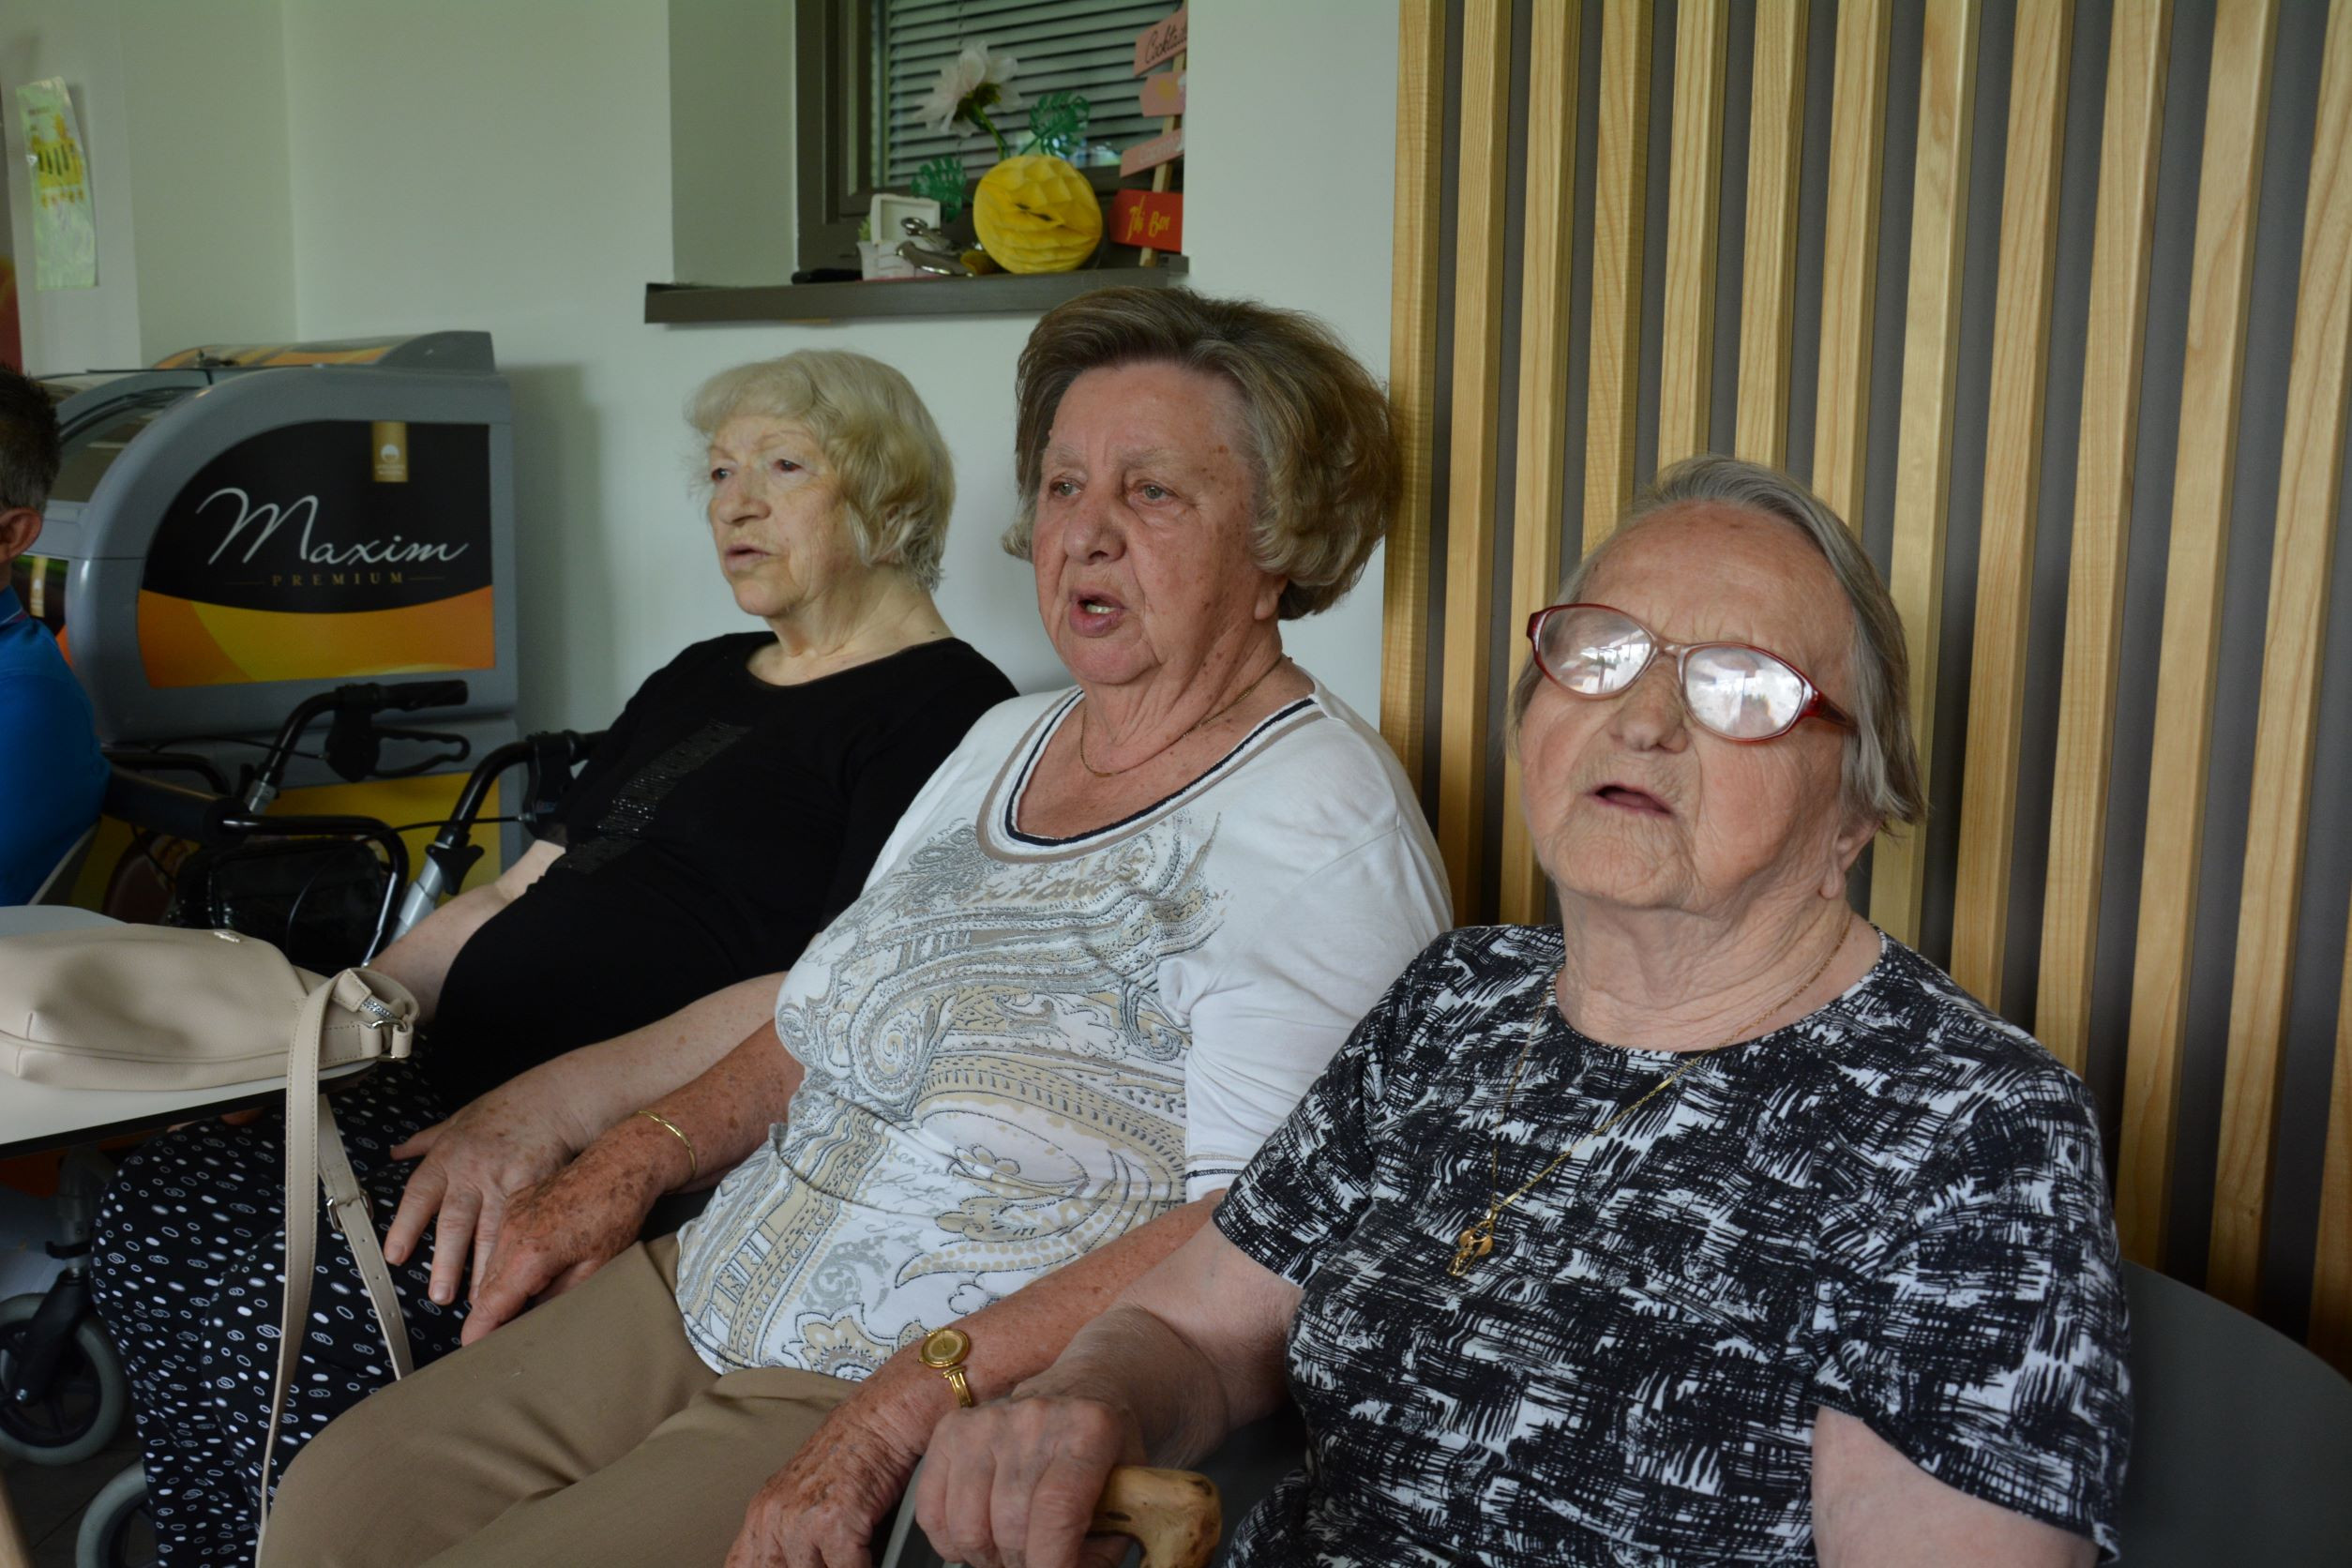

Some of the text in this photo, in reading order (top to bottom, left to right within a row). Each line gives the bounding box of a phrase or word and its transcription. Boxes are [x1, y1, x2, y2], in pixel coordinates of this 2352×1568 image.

[1148, 210, 1171, 238] Bar
[194, 487, 470, 566] Maxim
[271, 572, 404, 587] PREMIUM
